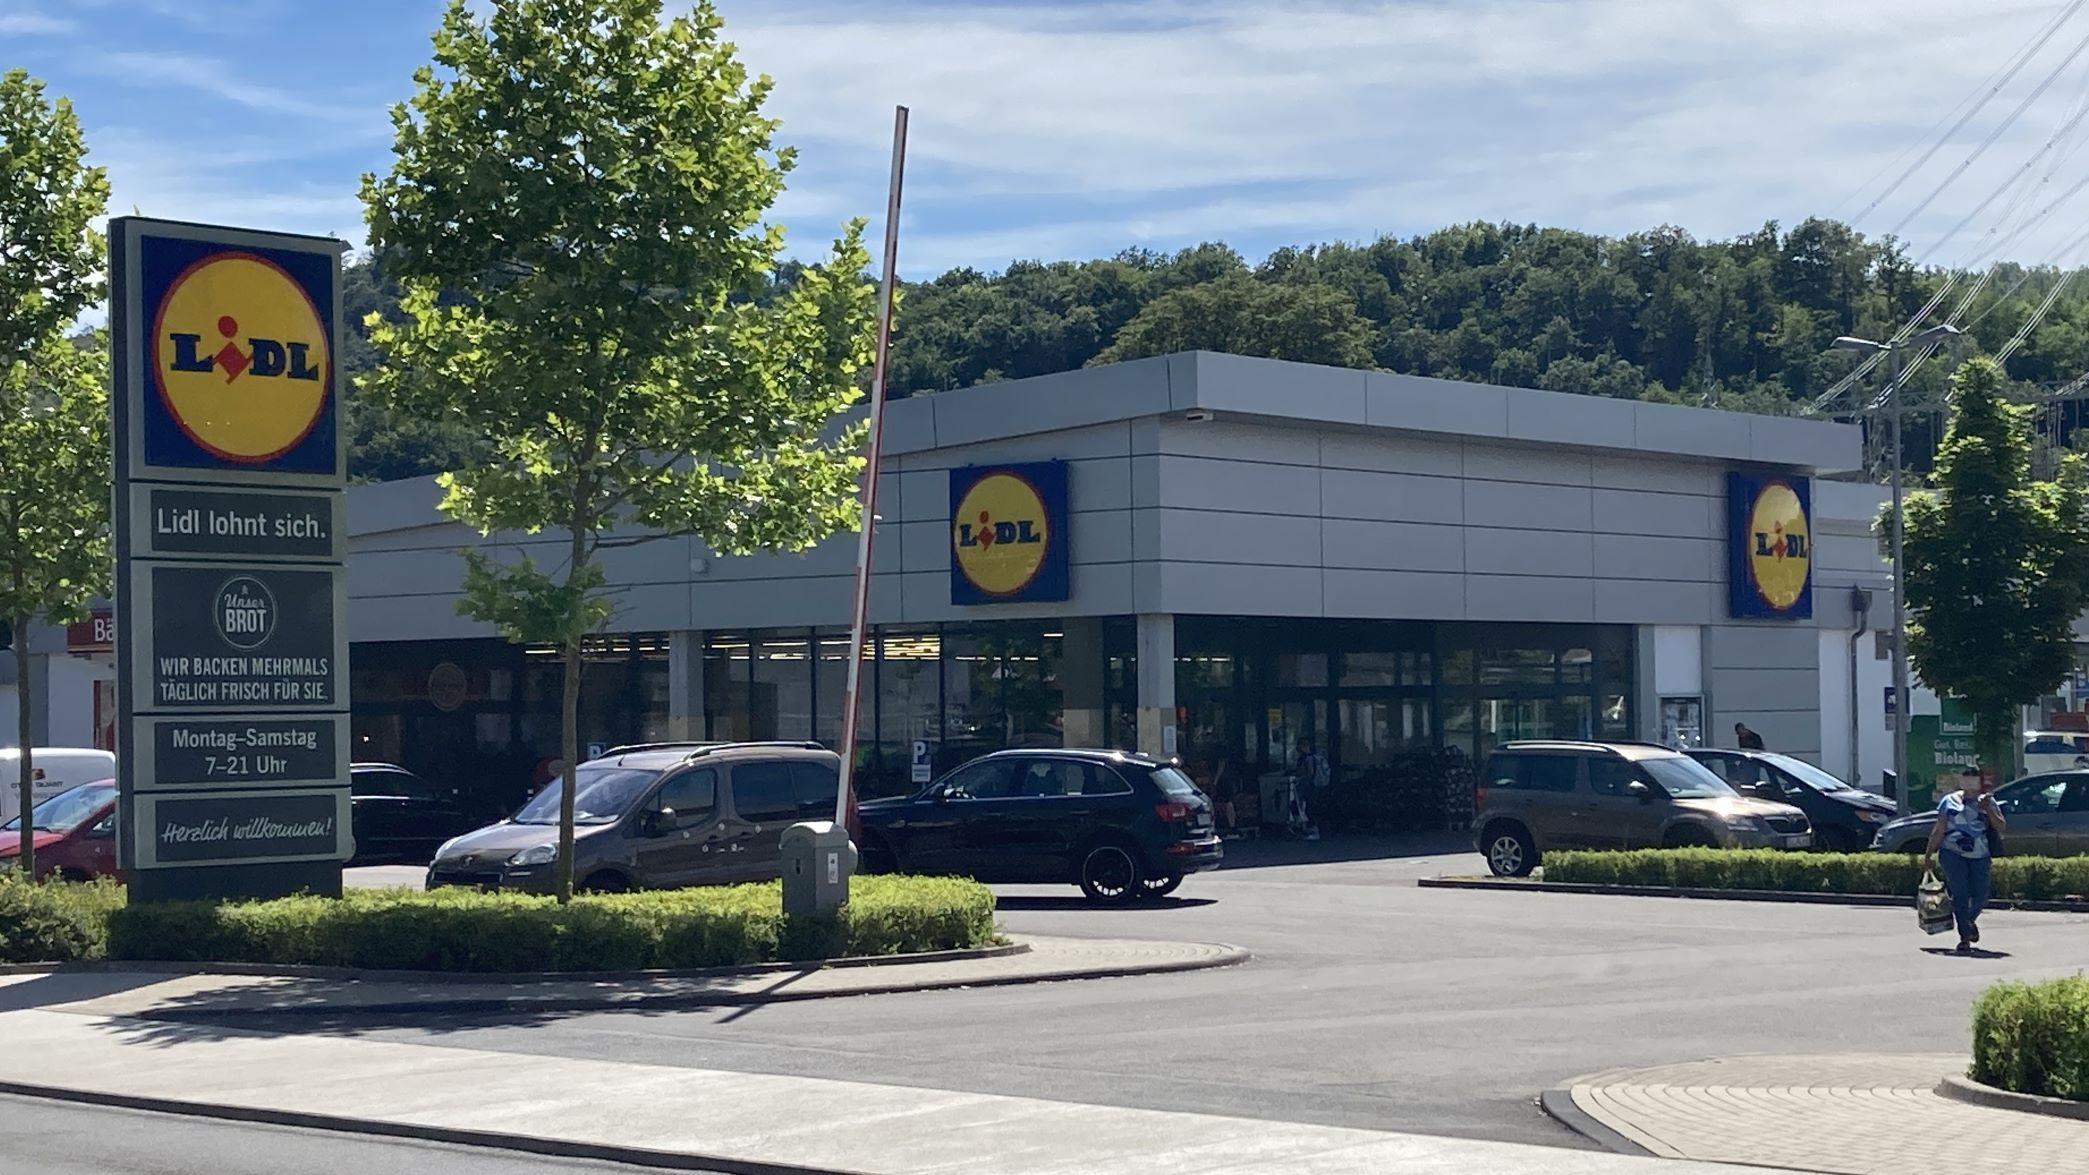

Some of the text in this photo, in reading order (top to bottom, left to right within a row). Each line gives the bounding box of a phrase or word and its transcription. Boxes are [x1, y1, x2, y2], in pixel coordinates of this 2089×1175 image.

[158, 508, 326, 538] Lidl lohnt sich.
[224, 593, 265, 609] Unser
[226, 609, 267, 633] BROT
[160, 657, 328, 676] WIR BACKEN MEHRMALS
[160, 679, 217, 701] TÄGLICH
[221, 682, 269, 701] FRISCH
[274, 678, 300, 700] FÜR
[256, 756, 288, 774] Uhr
[161, 817, 332, 844] Herzlich willkommen!
